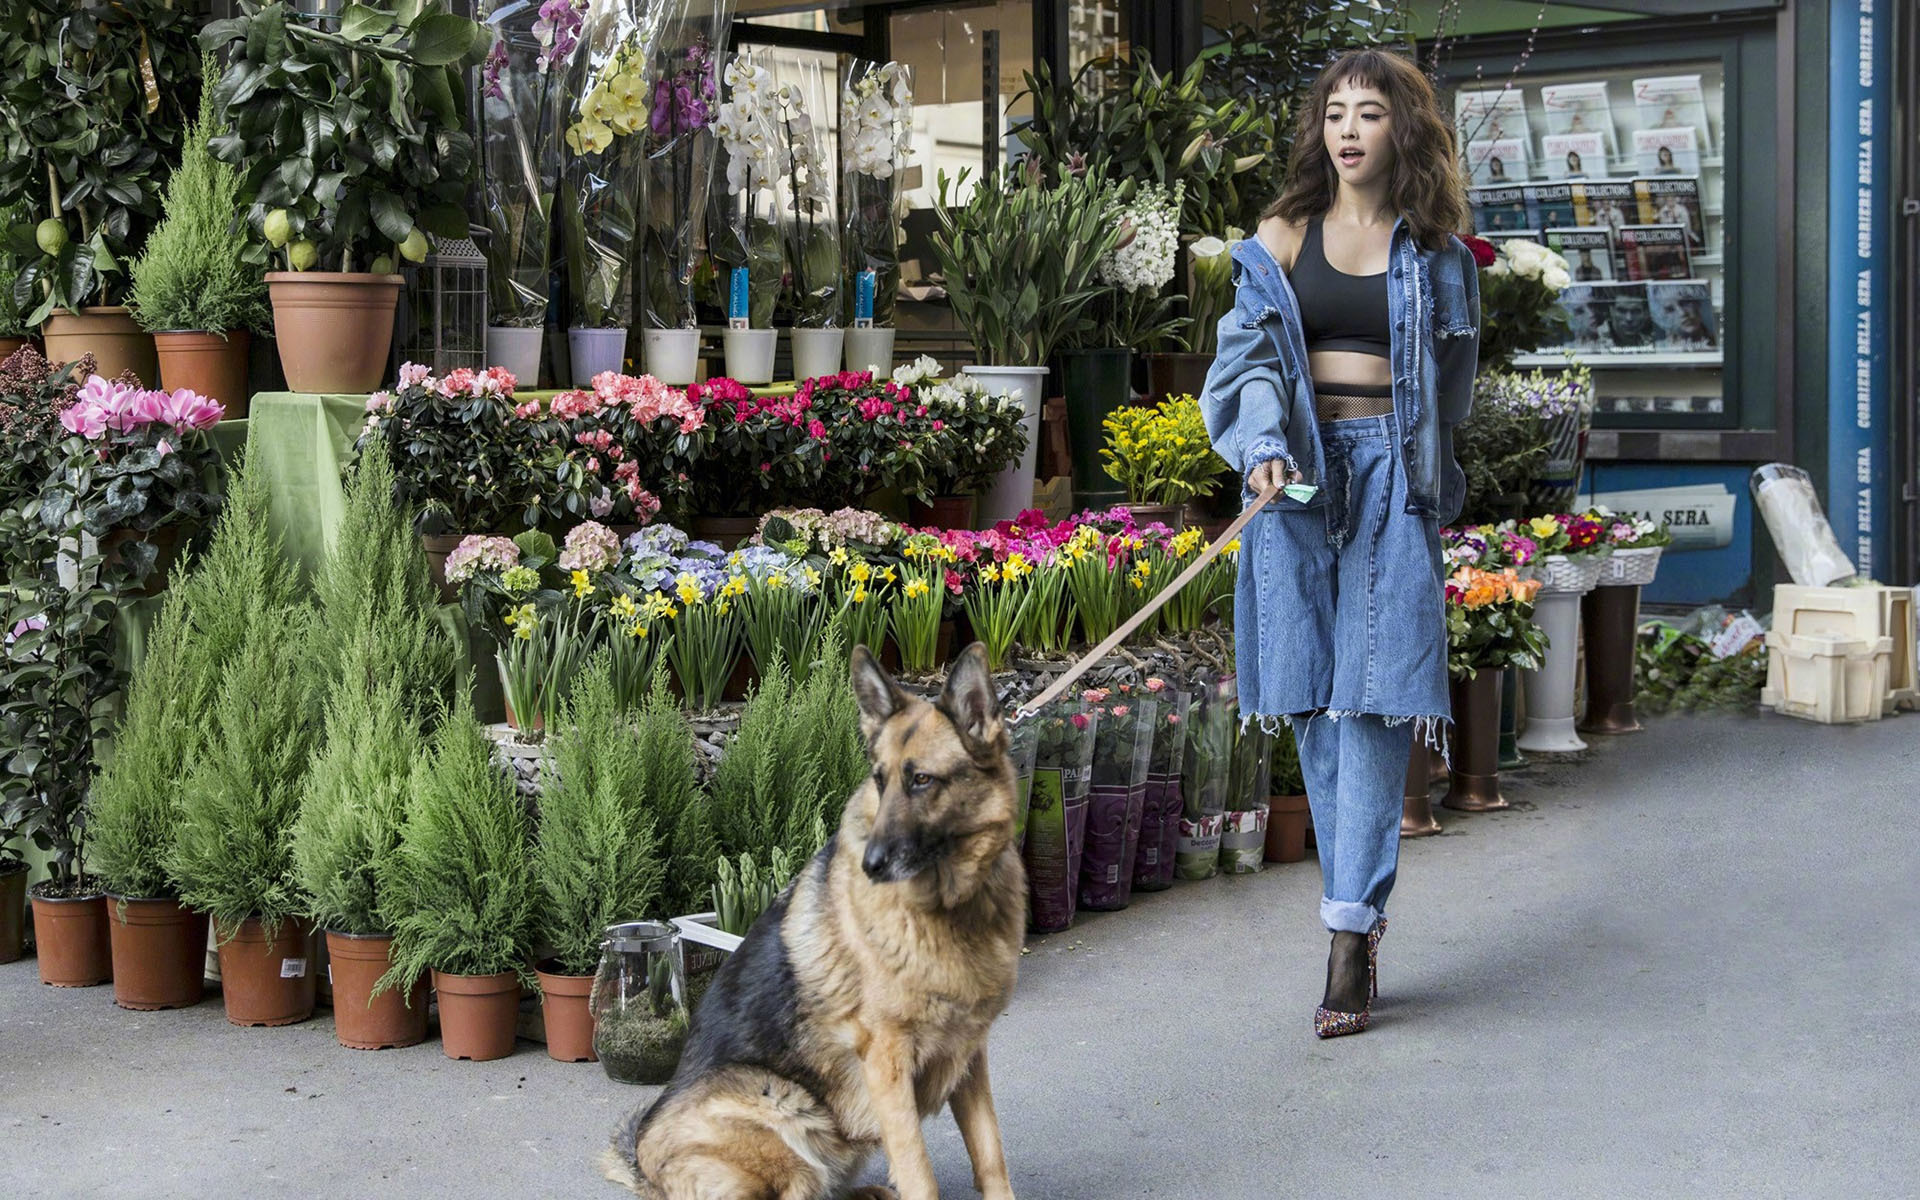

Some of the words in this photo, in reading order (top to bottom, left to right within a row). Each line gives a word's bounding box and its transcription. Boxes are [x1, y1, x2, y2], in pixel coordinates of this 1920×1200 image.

[1859, 17, 1872, 87] CORRIERE
[1858, 99, 1872, 136] SERA
[1858, 141, 1872, 185] DELLA
[1858, 187, 1872, 257] CORRIERE
[1857, 270, 1871, 307] SERA
[1857, 311, 1871, 355] DELLA
[1857, 358, 1871, 428] CORRIERE
[1857, 447, 1871, 484] SERA
[1663, 510, 1710, 526] SERA
[1857, 488, 1871, 532] DELLA
